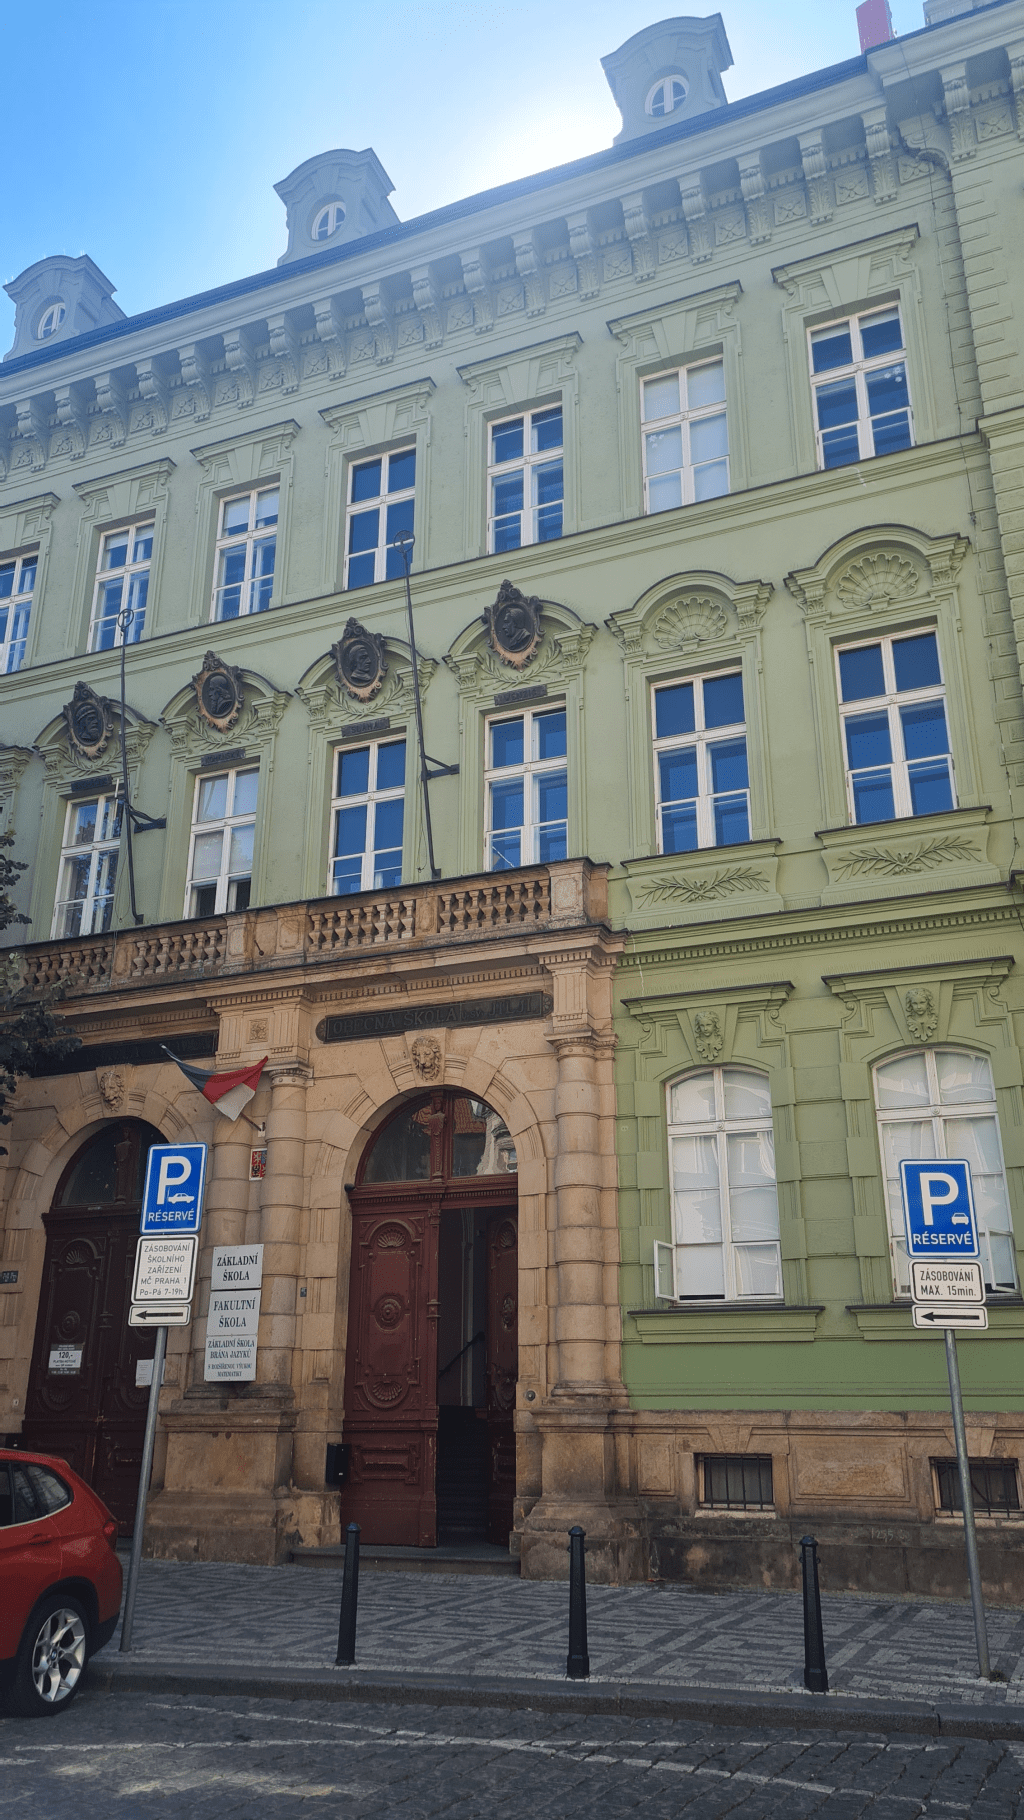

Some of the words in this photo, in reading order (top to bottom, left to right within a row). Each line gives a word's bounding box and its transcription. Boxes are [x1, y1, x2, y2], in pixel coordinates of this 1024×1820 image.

[157, 1156, 191, 1204] P
[920, 1173, 958, 1225] P
[148, 1208, 194, 1222] RÉSERVÉ
[913, 1231, 972, 1245] RÉSERVÉ
[144, 1243, 190, 1252] ZÁSOBOVÁNÍ
[147, 1254, 185, 1263] ŠKOLNÍHO
[217, 1252, 258, 1266] ZÁKLADNÍ
[147, 1265, 182, 1274] ZAŘÍZENÍ
[223, 1269, 249, 1281] ŠKOLA
[920, 1268, 973, 1281] ZÁSOBOVÁNÍ
[140, 1276, 151, 1285] MČ
[921, 1285, 943, 1295] MAX.
[947, 1285, 976, 1296] 15min.
[213, 1297, 256, 1311] FAKULTNÍ
[219, 1315, 246, 1327] ŠKOLA
[208, 1338, 236, 1348] ZÁKLADNÍ
[236, 1338, 254, 1347] ŠKOLA
